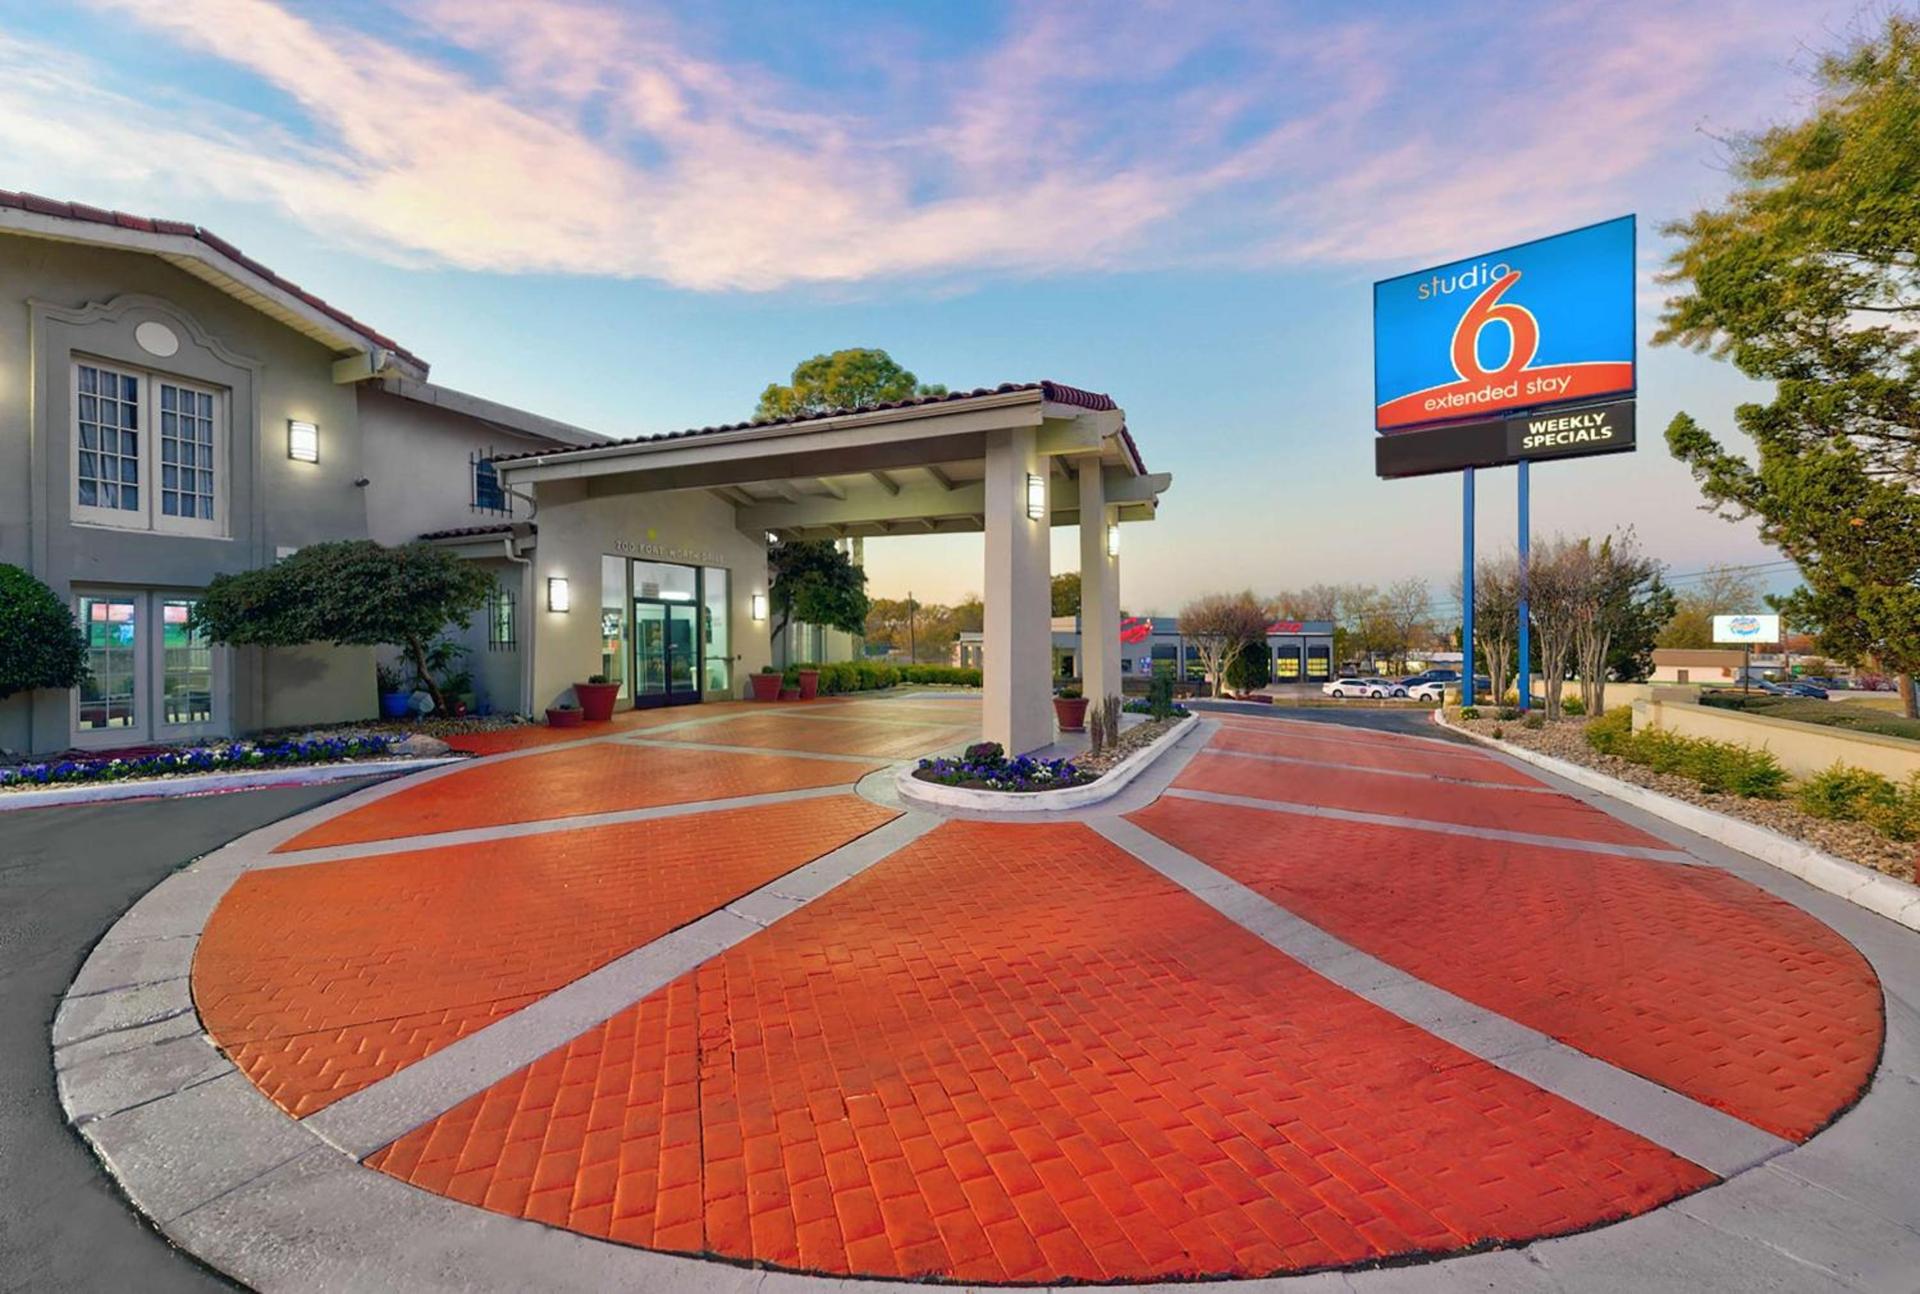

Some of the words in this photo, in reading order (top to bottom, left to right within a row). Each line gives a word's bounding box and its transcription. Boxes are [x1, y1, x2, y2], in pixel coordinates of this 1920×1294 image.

[1417, 263, 1510, 300] studio
[1450, 270, 1540, 380] 6
[1424, 381, 1518, 411] extended
[1526, 375, 1572, 394] stay
[1522, 426, 1613, 449] SPECIALS
[1528, 412, 1606, 435] WEEKLY
